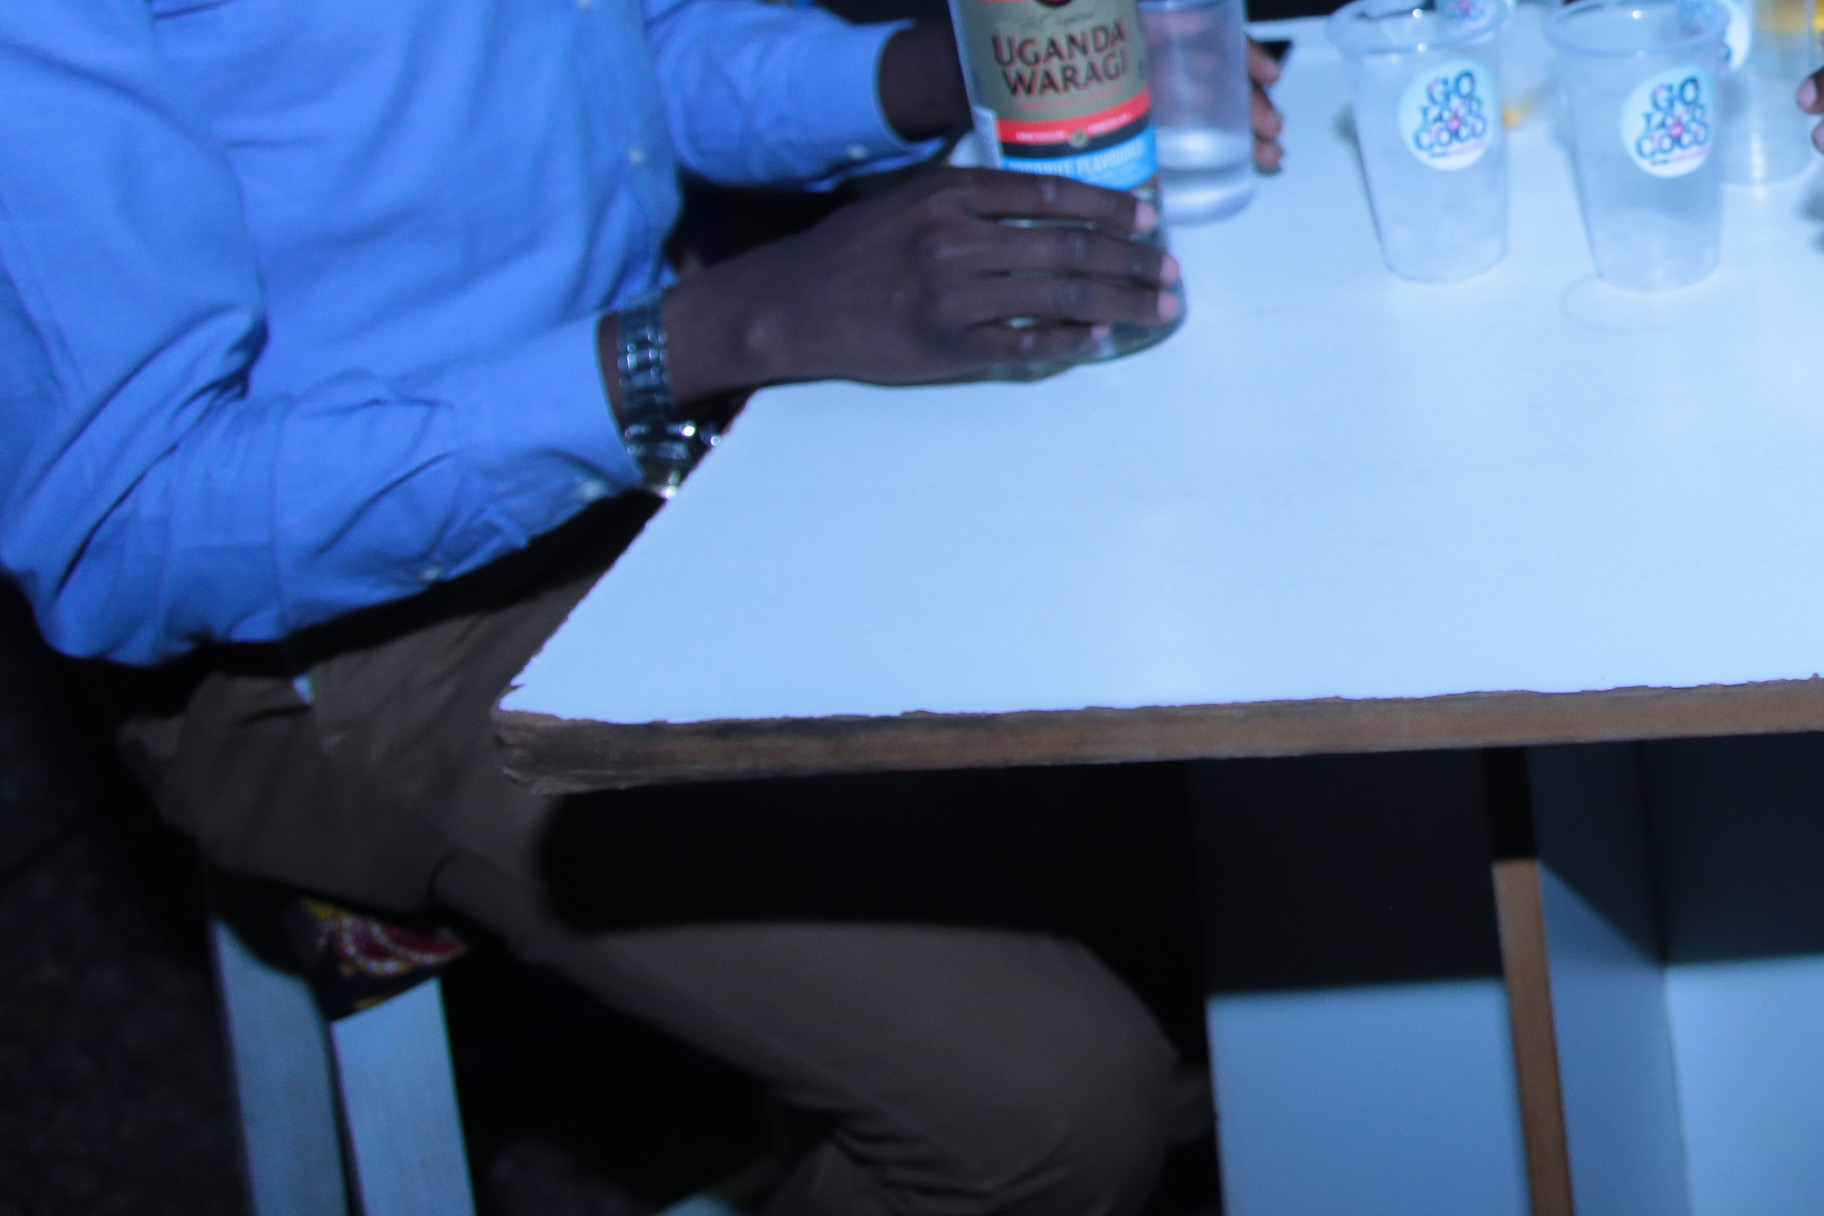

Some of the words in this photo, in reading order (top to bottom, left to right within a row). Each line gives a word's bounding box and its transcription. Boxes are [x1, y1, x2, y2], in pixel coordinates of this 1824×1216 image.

[992, 18, 1127, 68] UGANDA
[1001, 48, 1129, 98] WARAGI
[1426, 70, 1475, 105] GO
[1650, 76, 1700, 112] GO
